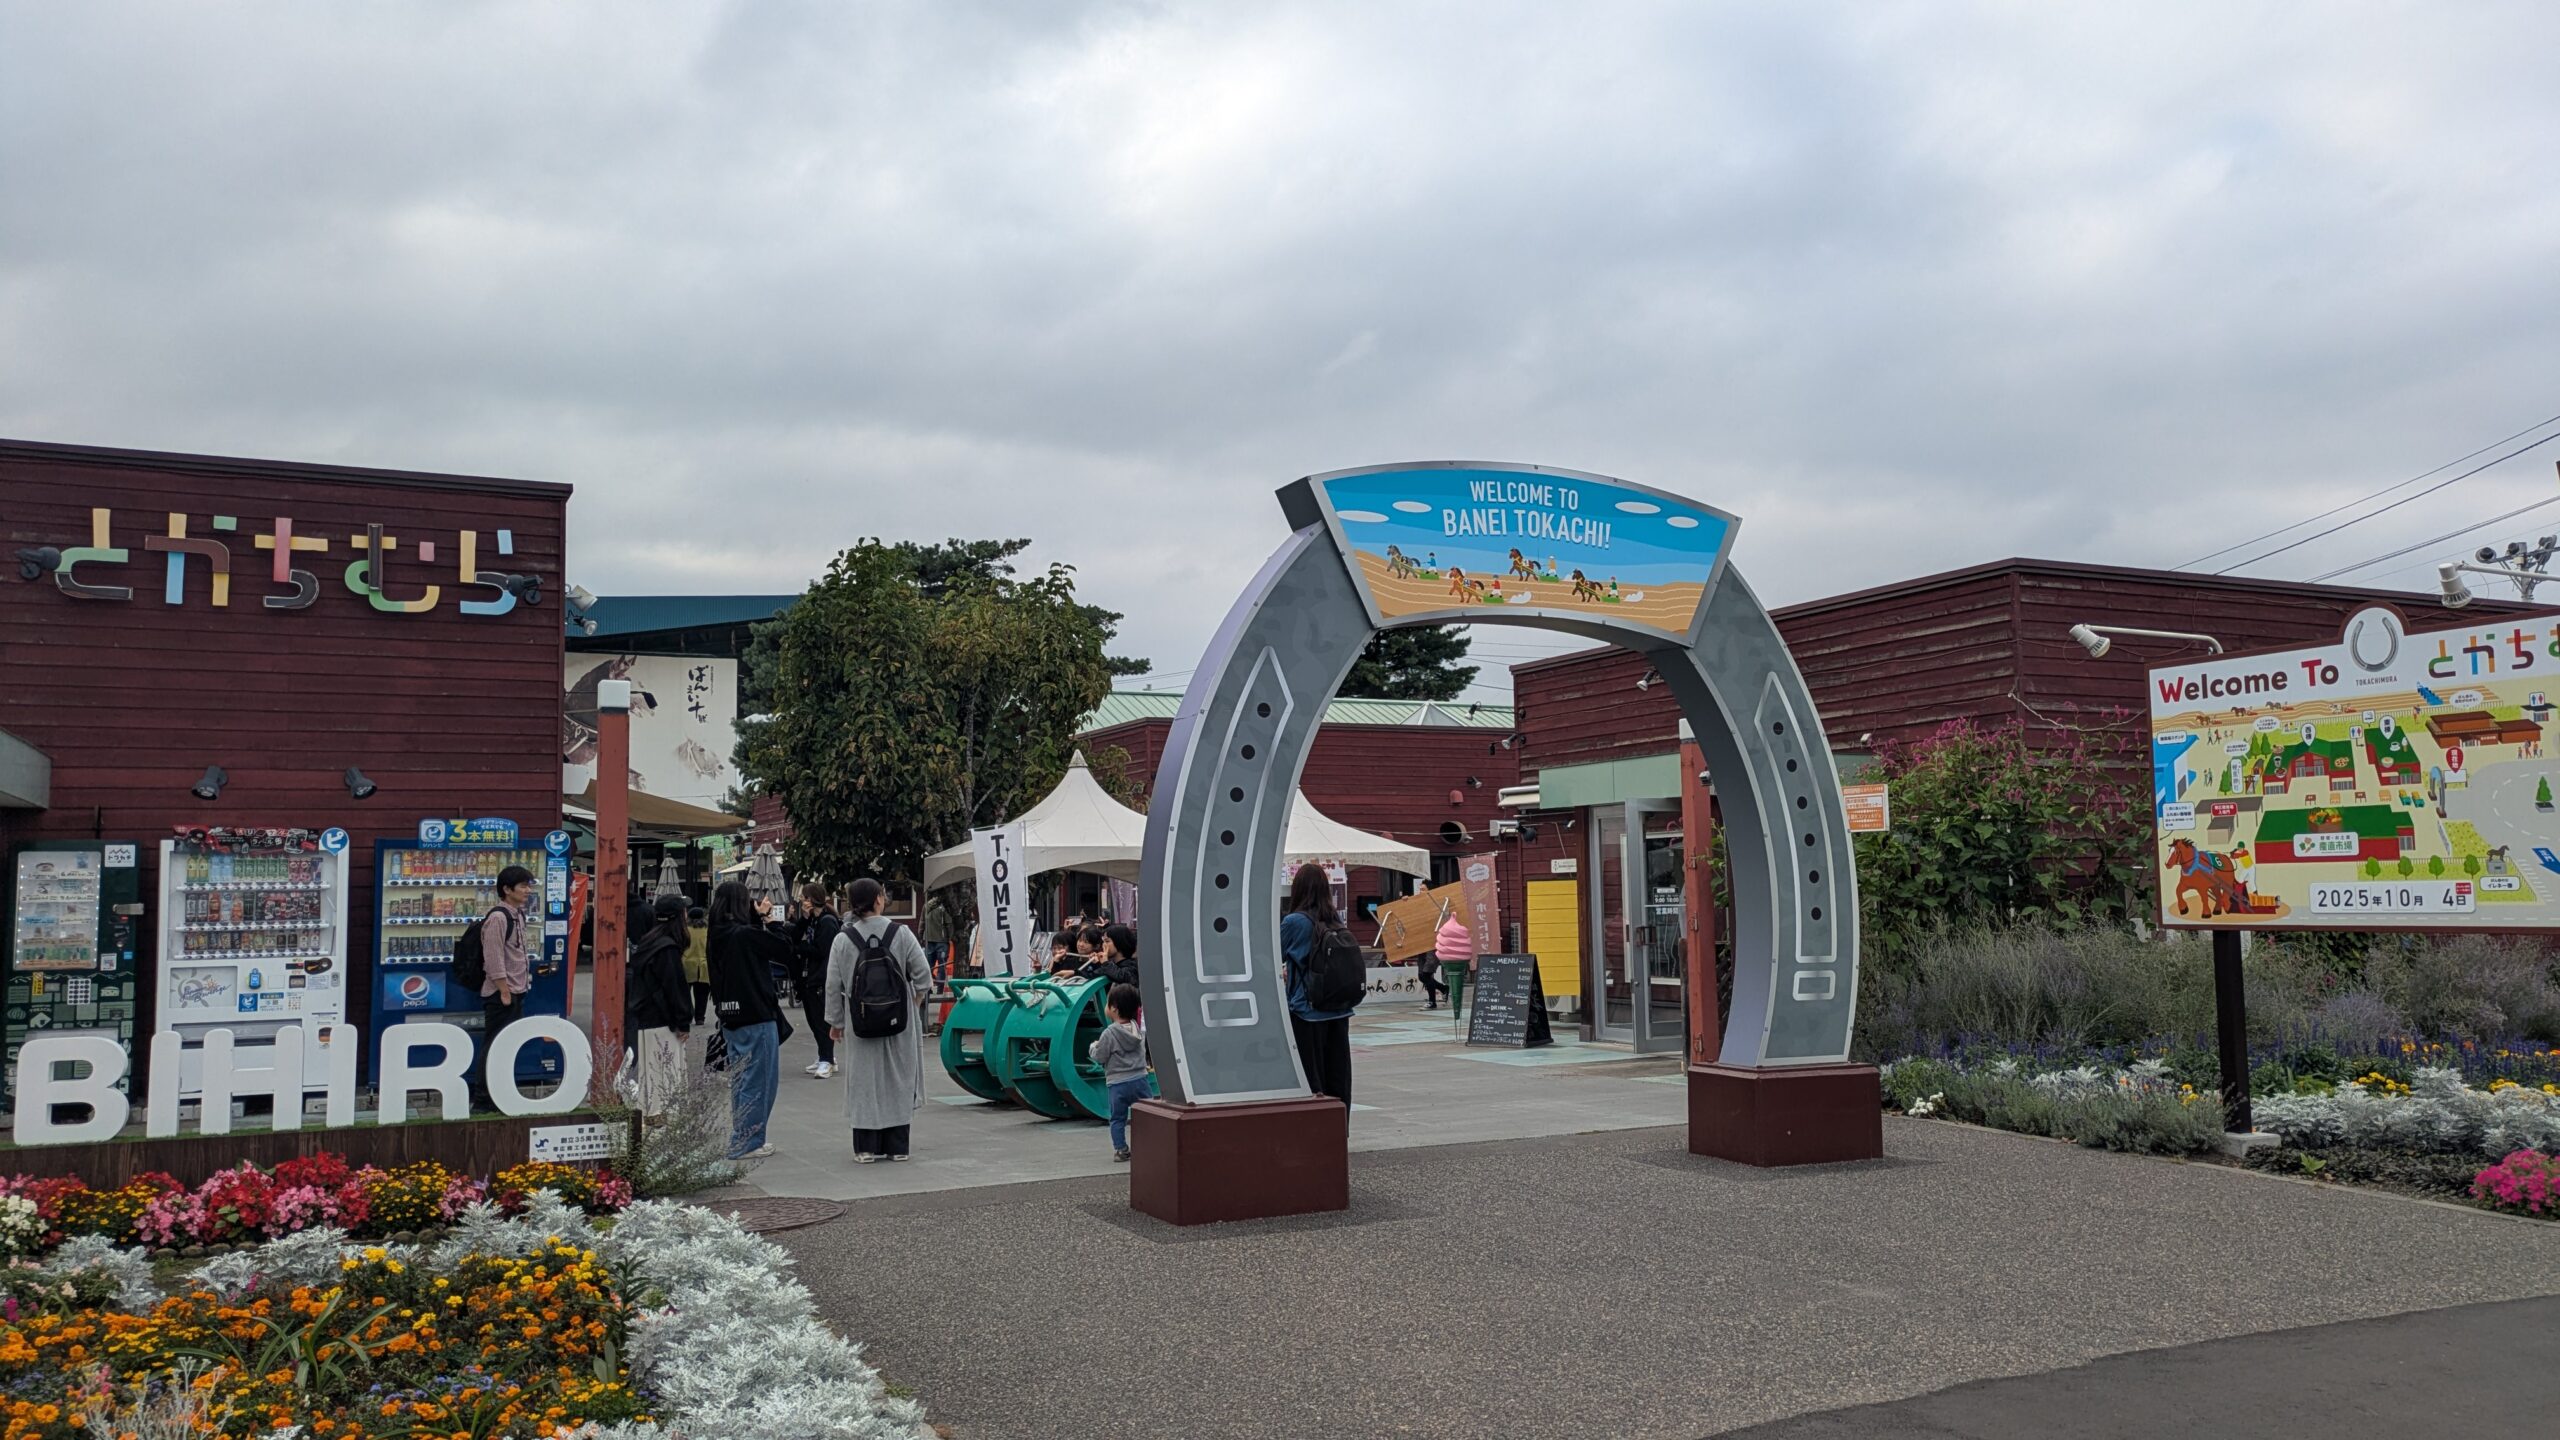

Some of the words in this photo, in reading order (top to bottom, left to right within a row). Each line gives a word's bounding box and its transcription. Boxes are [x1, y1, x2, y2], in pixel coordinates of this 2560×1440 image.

[1470, 480, 1553, 507] WELCOME
[1558, 488, 1579, 511] TO
[1442, 508, 1508, 537] BANEI
[1514, 509, 1611, 549] TOKACHI!
[54, 507, 518, 616] とかちむら
[2158, 671, 2288, 704] Welcome
[2301, 659, 2339, 687] To
[2355, 675, 2398, 687] TOKACHIMURA
[2319, 841, 2352, 851] 産直市場
[1476, 903, 1491, 954] ホットドッ
[1496, 957, 1519, 965] MENU
[403, 998, 427, 1008] pepsi
